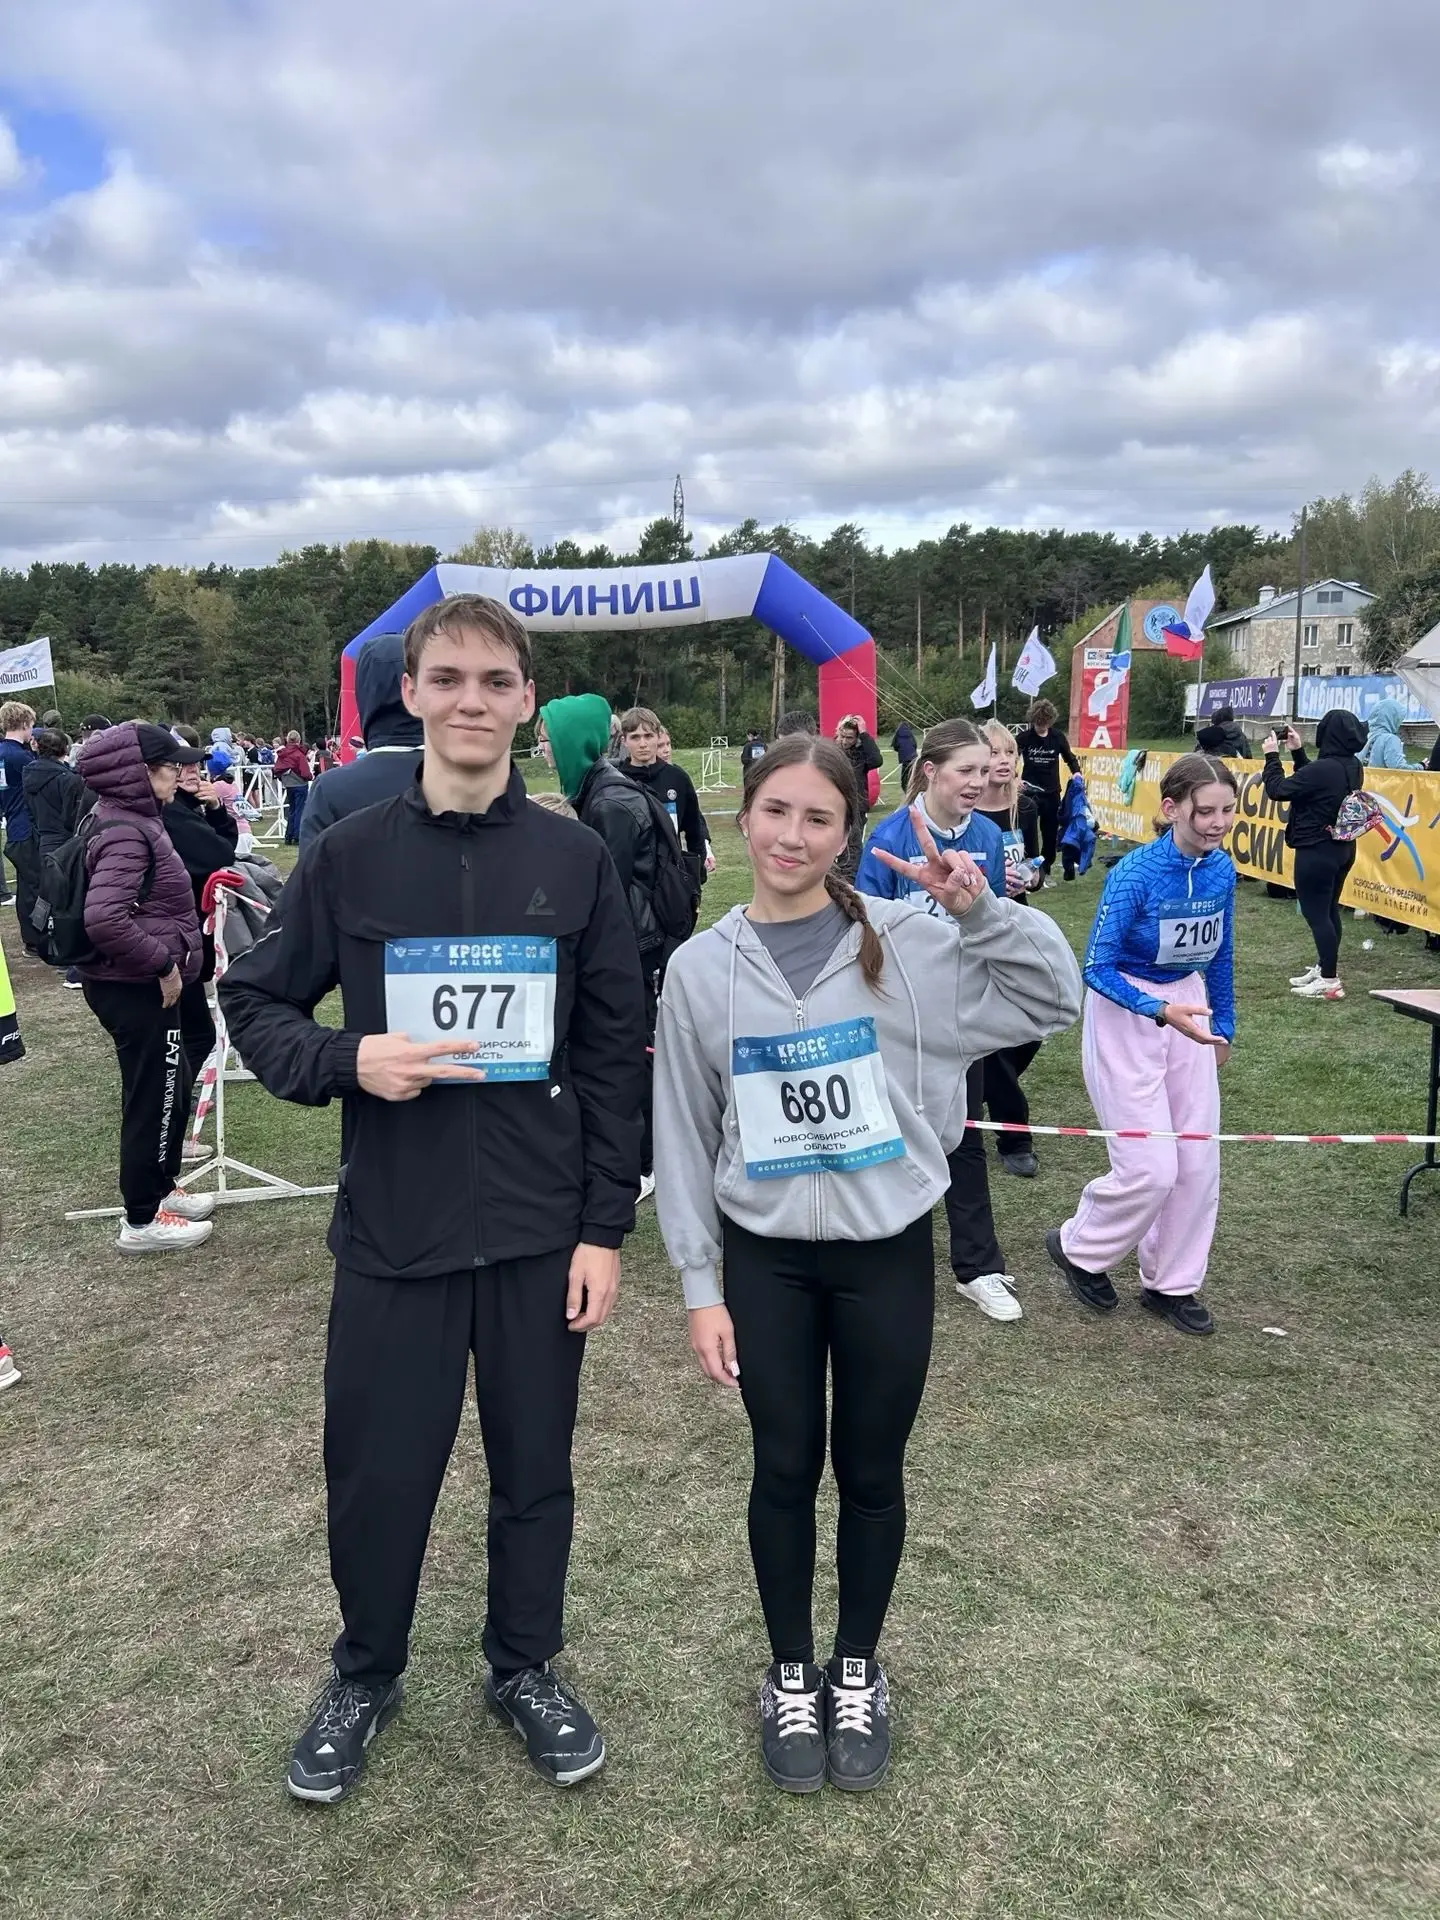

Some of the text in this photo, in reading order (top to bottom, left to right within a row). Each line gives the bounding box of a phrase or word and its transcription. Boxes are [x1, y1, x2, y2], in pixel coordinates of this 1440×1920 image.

[509, 576, 700, 616] ФИНИШ
[1229, 686, 1253, 708] ADRIA
[1384, 898, 1428, 916] АТЛЕТИКИ
[1174, 917, 1220, 948] 2100
[449, 944, 503, 959] КРОСС
[449, 959, 503, 967] НАЦИИ
[433, 984, 516, 1031] 677
[165, 1029, 180, 1066] EA7
[452, 1051, 503, 1060] ОБЛАСТЬ
[777, 1036, 827, 1058] КРОСС
[780, 1051, 829, 1065] НАЦИИ
[781, 1074, 851, 1125] 680
[773, 1124, 870, 1144] НОВОСИБИРСКАЯ
[803, 1142, 846, 1151] ОБЛАСТЬ
[843, 1154, 868, 1165] ДЕНЬ
